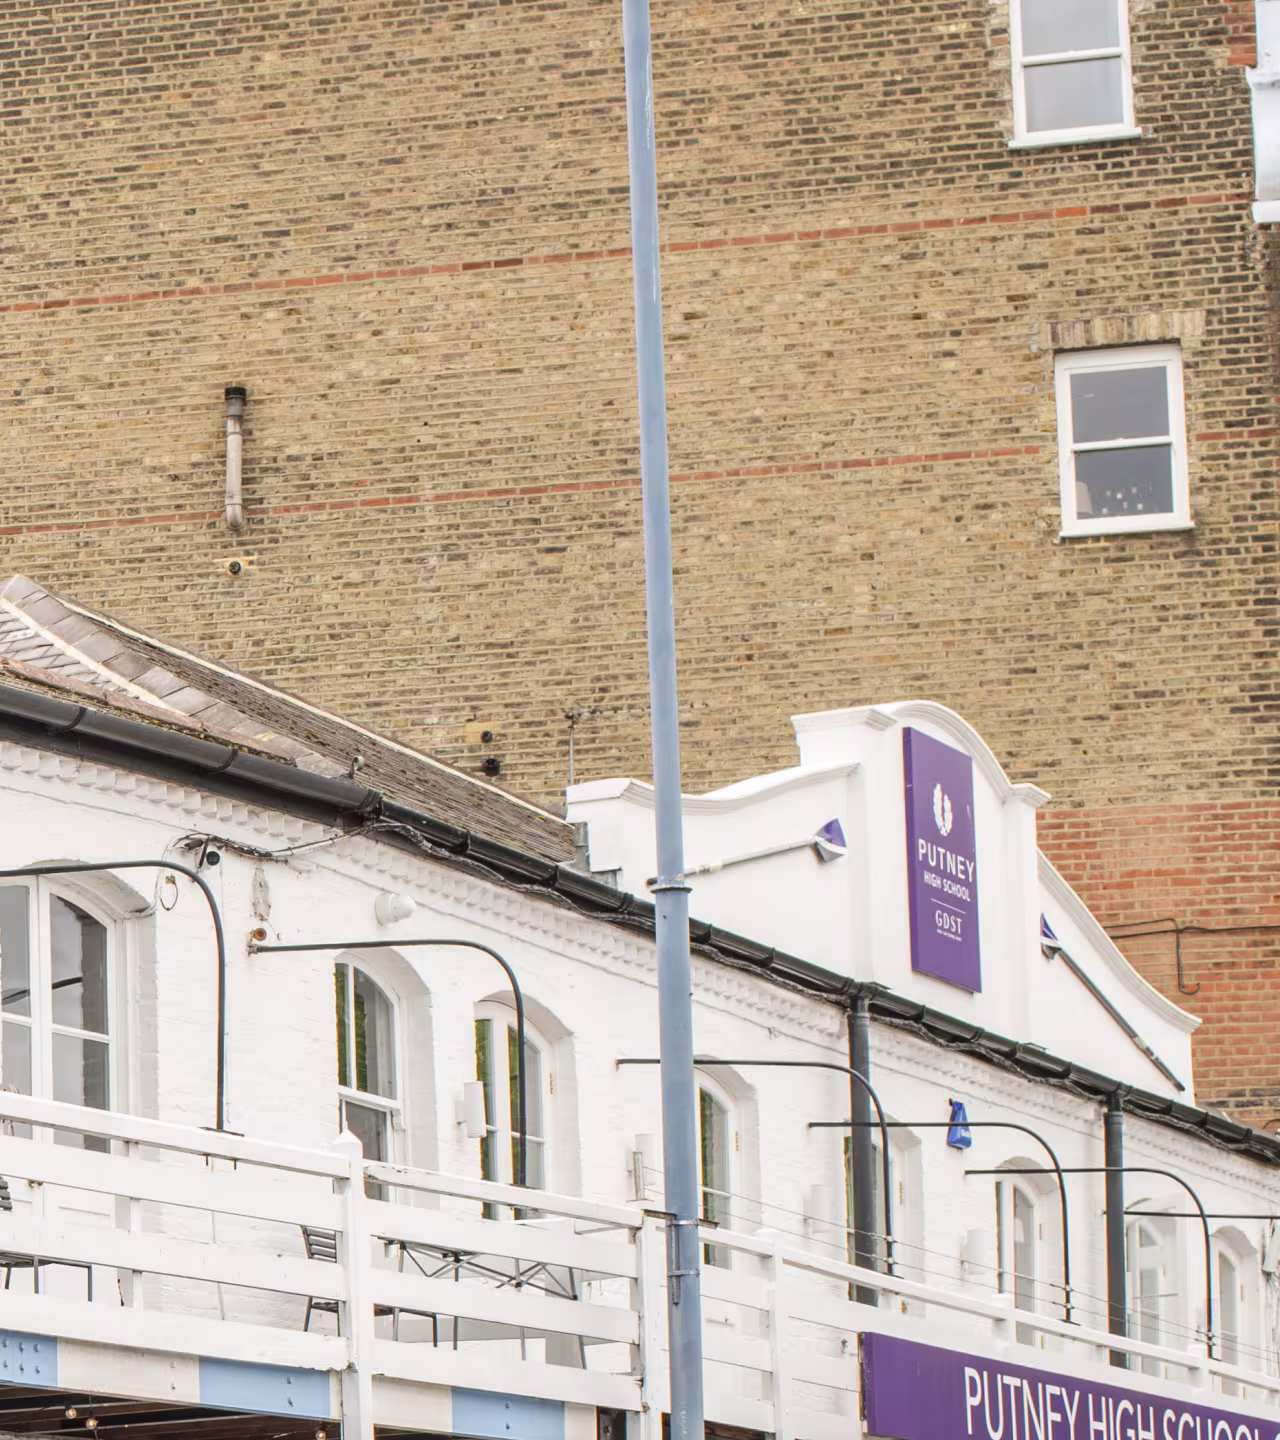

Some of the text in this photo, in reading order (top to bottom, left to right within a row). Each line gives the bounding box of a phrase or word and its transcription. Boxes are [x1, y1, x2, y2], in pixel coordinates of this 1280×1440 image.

[918, 838, 974, 882] PUTNEY
[923, 870, 971, 902] HIGH SCHOOL
[935, 910, 962, 934] GDST
